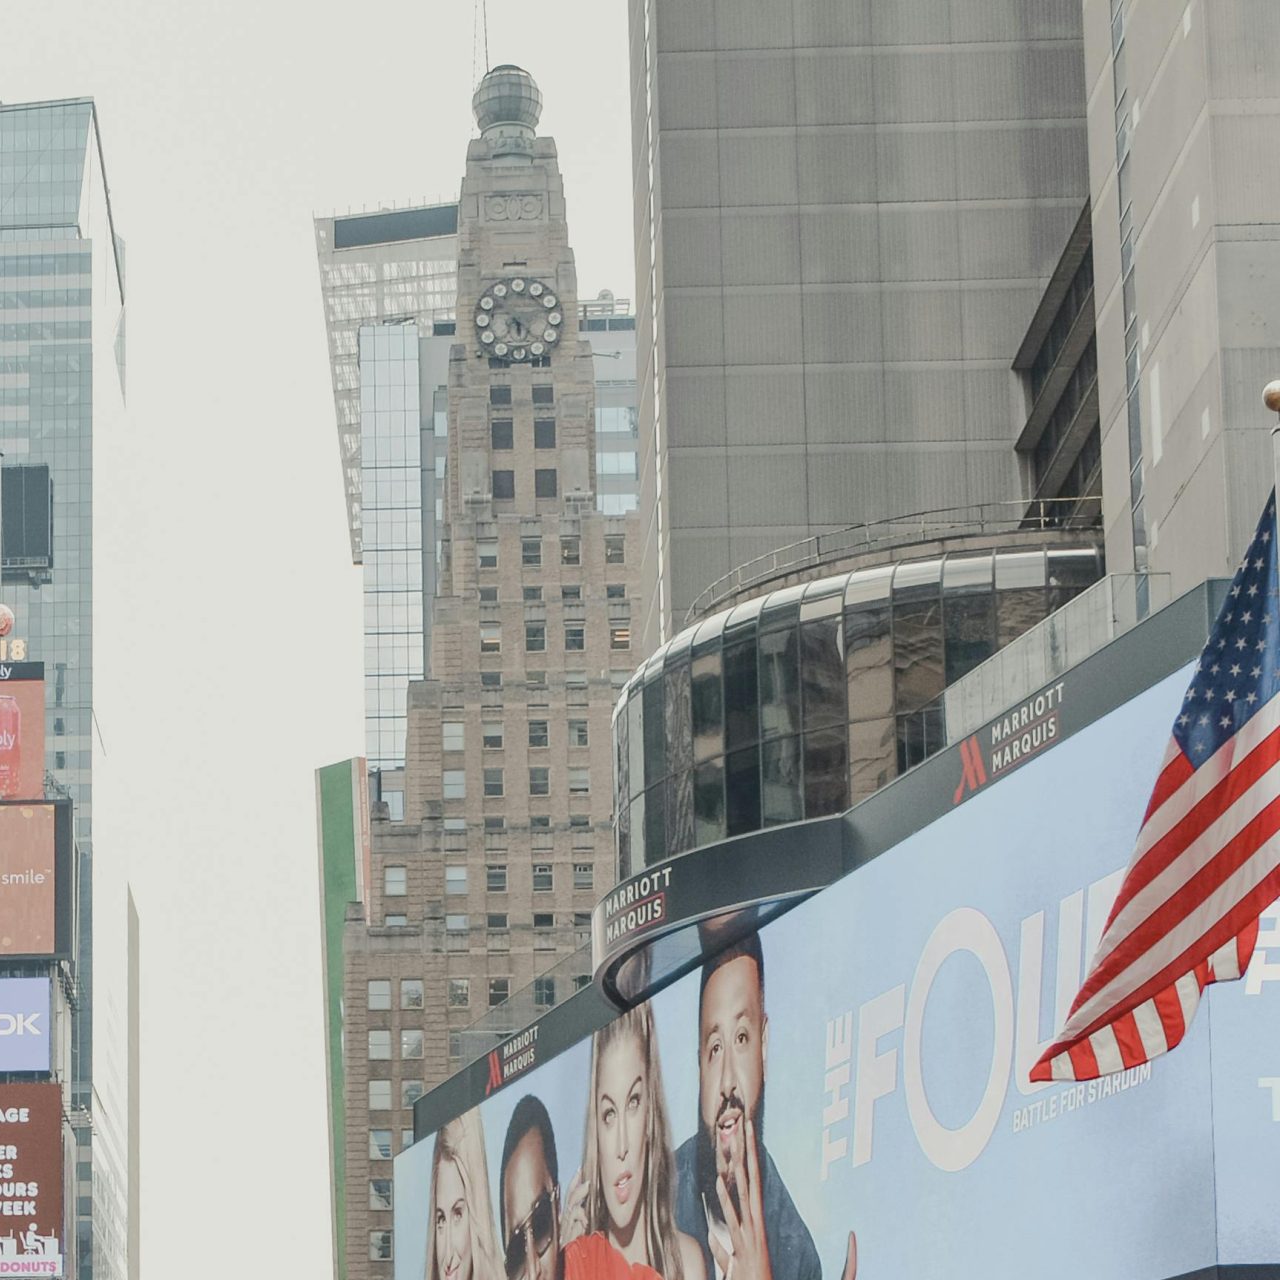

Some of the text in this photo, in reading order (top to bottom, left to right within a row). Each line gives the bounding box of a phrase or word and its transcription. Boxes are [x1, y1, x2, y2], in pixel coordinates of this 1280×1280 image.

[991, 682, 1064, 745] MARRIOTT
[992, 717, 1056, 773] MARQUIS
[605, 867, 671, 918] MARRIOTT
[606, 897, 663, 944] MARQUIS
[503, 1025, 539, 1057] MARRIOTT
[503, 1048, 535, 1079] MARQUIS
[820, 1011, 853, 1182] THE
[1012, 1061, 1153, 1133] BATTLE FOR STARDOM
[0, 1261, 57, 1273] DONUTS
